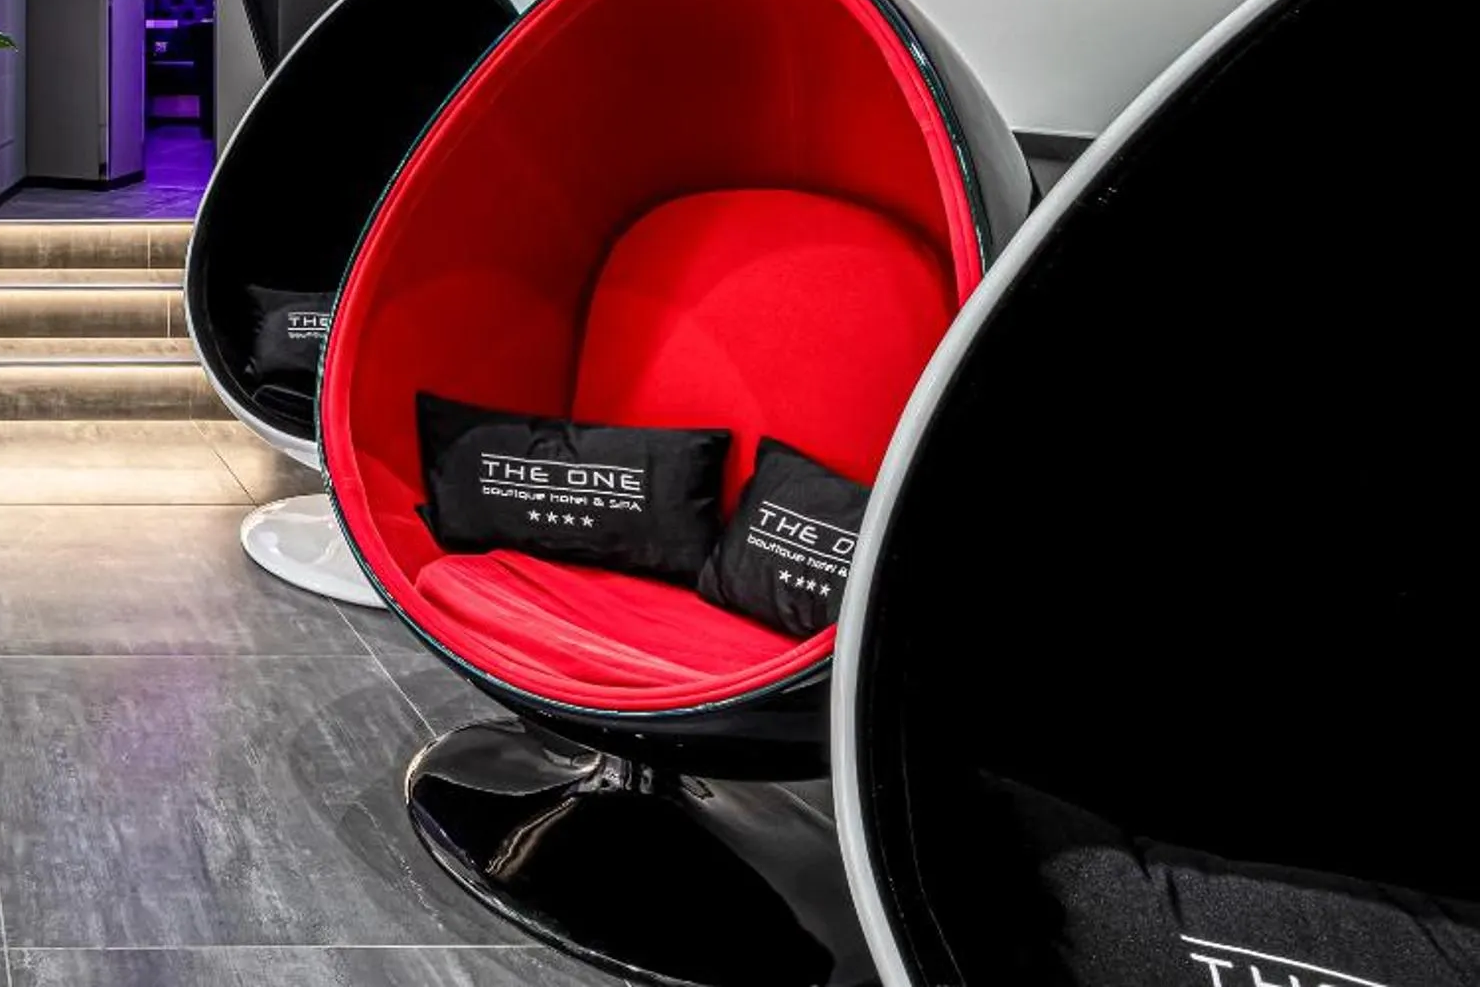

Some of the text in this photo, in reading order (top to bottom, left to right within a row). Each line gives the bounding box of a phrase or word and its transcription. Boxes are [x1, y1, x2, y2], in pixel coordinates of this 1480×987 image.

[482, 460, 641, 491] THE ONE
[482, 486, 643, 512] boutique hotel & SPA
[759, 508, 818, 545] THE
[1189, 952, 1338, 987] TH
